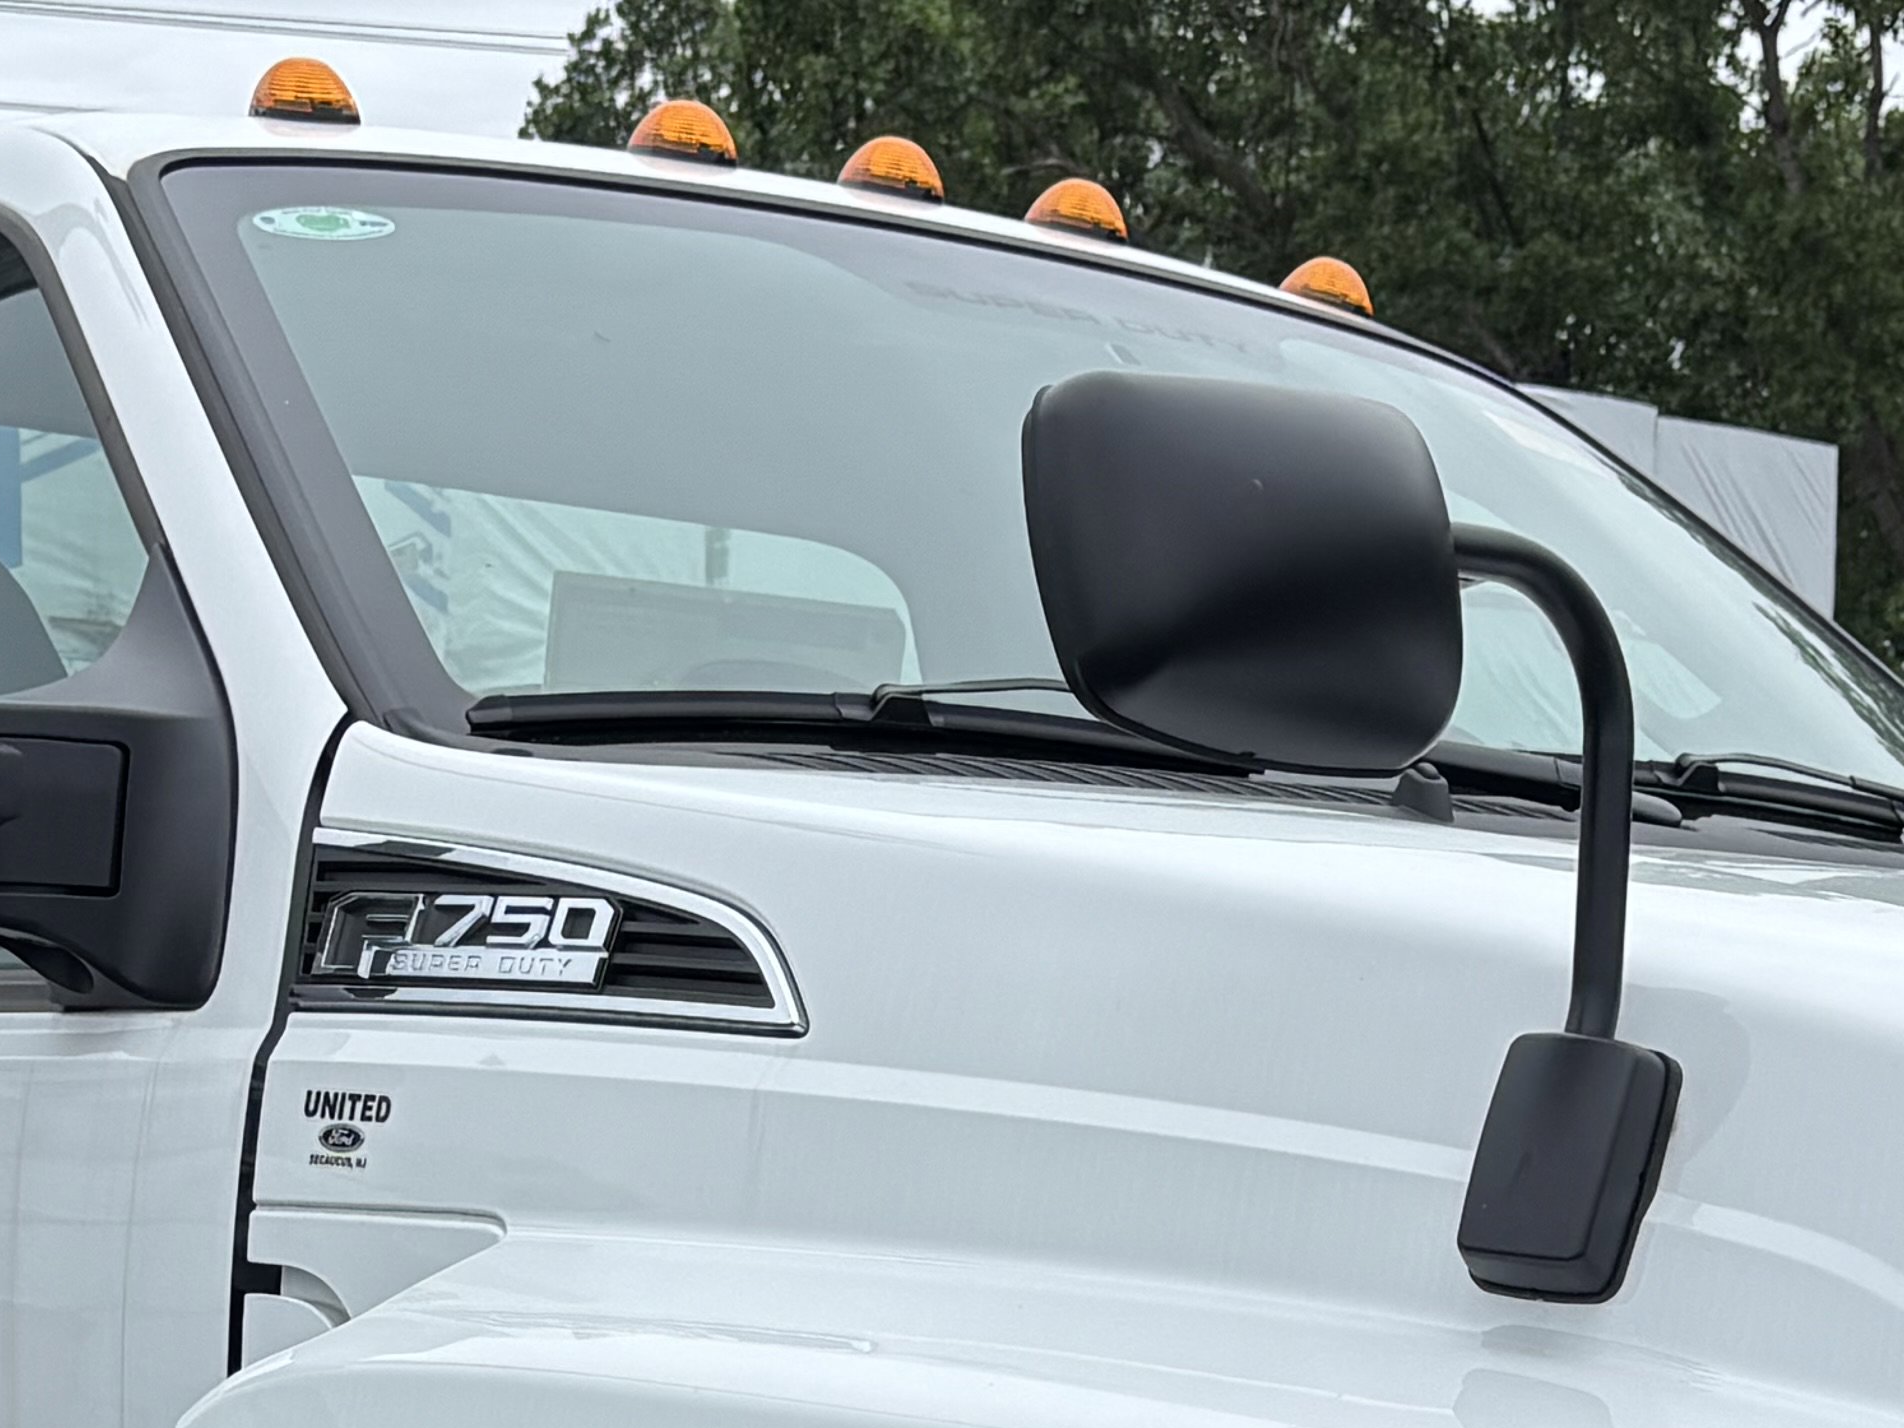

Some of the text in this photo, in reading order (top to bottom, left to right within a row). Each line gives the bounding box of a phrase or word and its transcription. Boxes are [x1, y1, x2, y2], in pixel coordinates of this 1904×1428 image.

[389, 951, 573, 979] SUPER DUTY
[304, 1089, 392, 1123] UNITED
